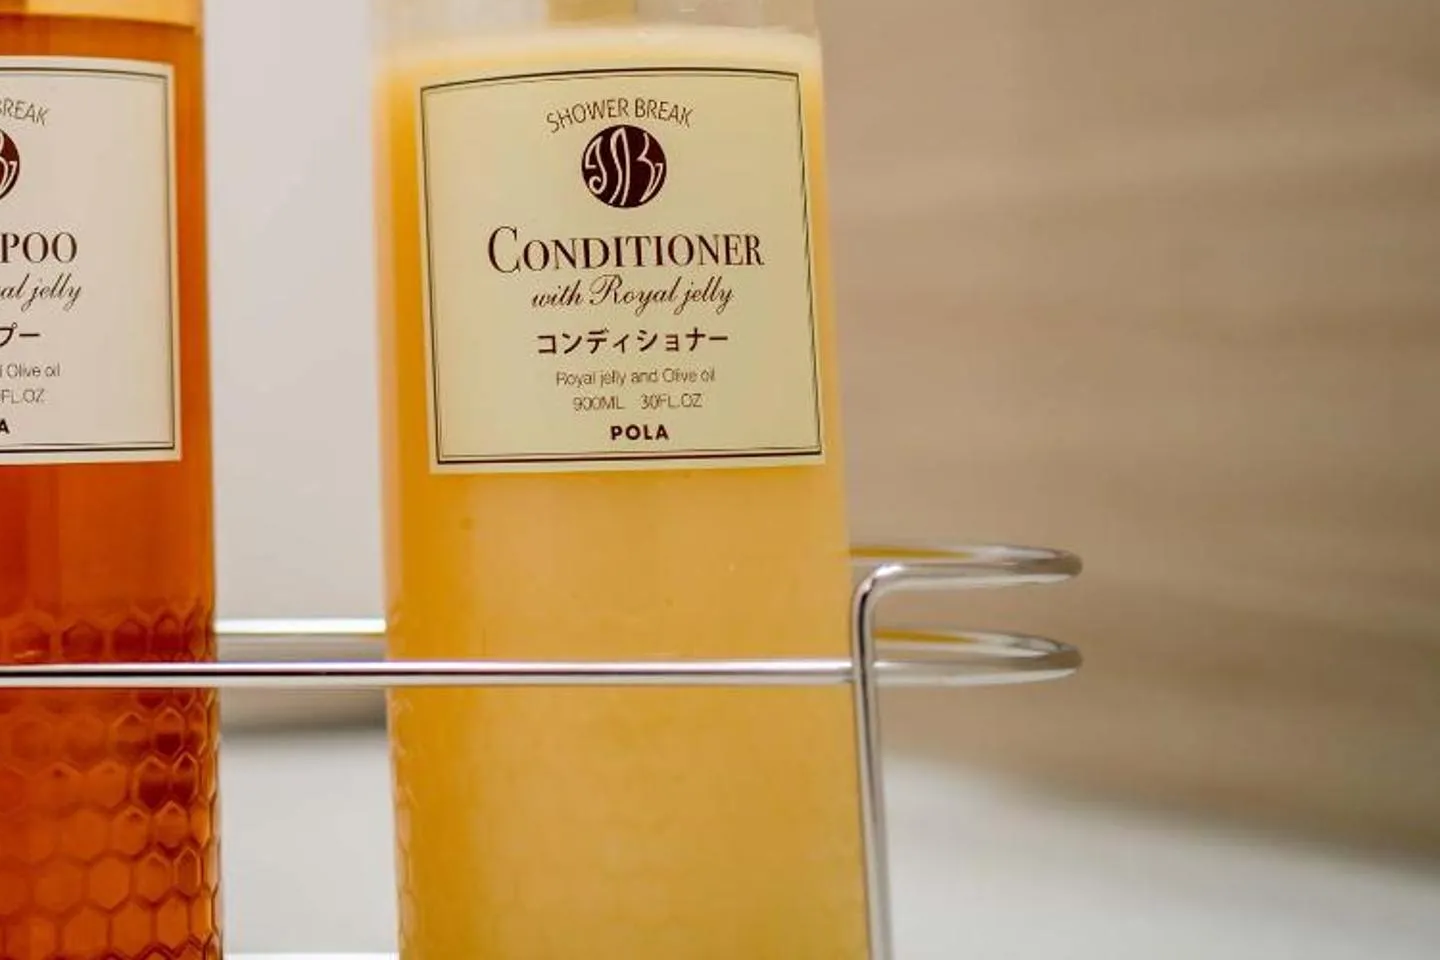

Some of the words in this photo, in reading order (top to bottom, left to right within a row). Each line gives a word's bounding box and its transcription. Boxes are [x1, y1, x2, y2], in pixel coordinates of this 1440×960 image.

[546, 98, 629, 133] SHOWER
[634, 98, 694, 127] BREAK
[488, 226, 765, 273] CONDITIONER
[21, 272, 83, 311] jelly
[531, 280, 584, 309] with
[589, 274, 680, 315] Royal
[674, 276, 734, 315] jelly
[538, 327, 728, 355] コンディショナー
[7, 364, 41, 378] Olive
[44, 364, 60, 377] oil
[556, 370, 596, 387] Royal
[599, 370, 626, 386] jelly
[631, 369, 658, 383] and
[662, 368, 698, 382] Olive
[701, 367, 715, 381] oil
[573, 396, 624, 410] 900ML
[611, 425, 669, 440] POLA
